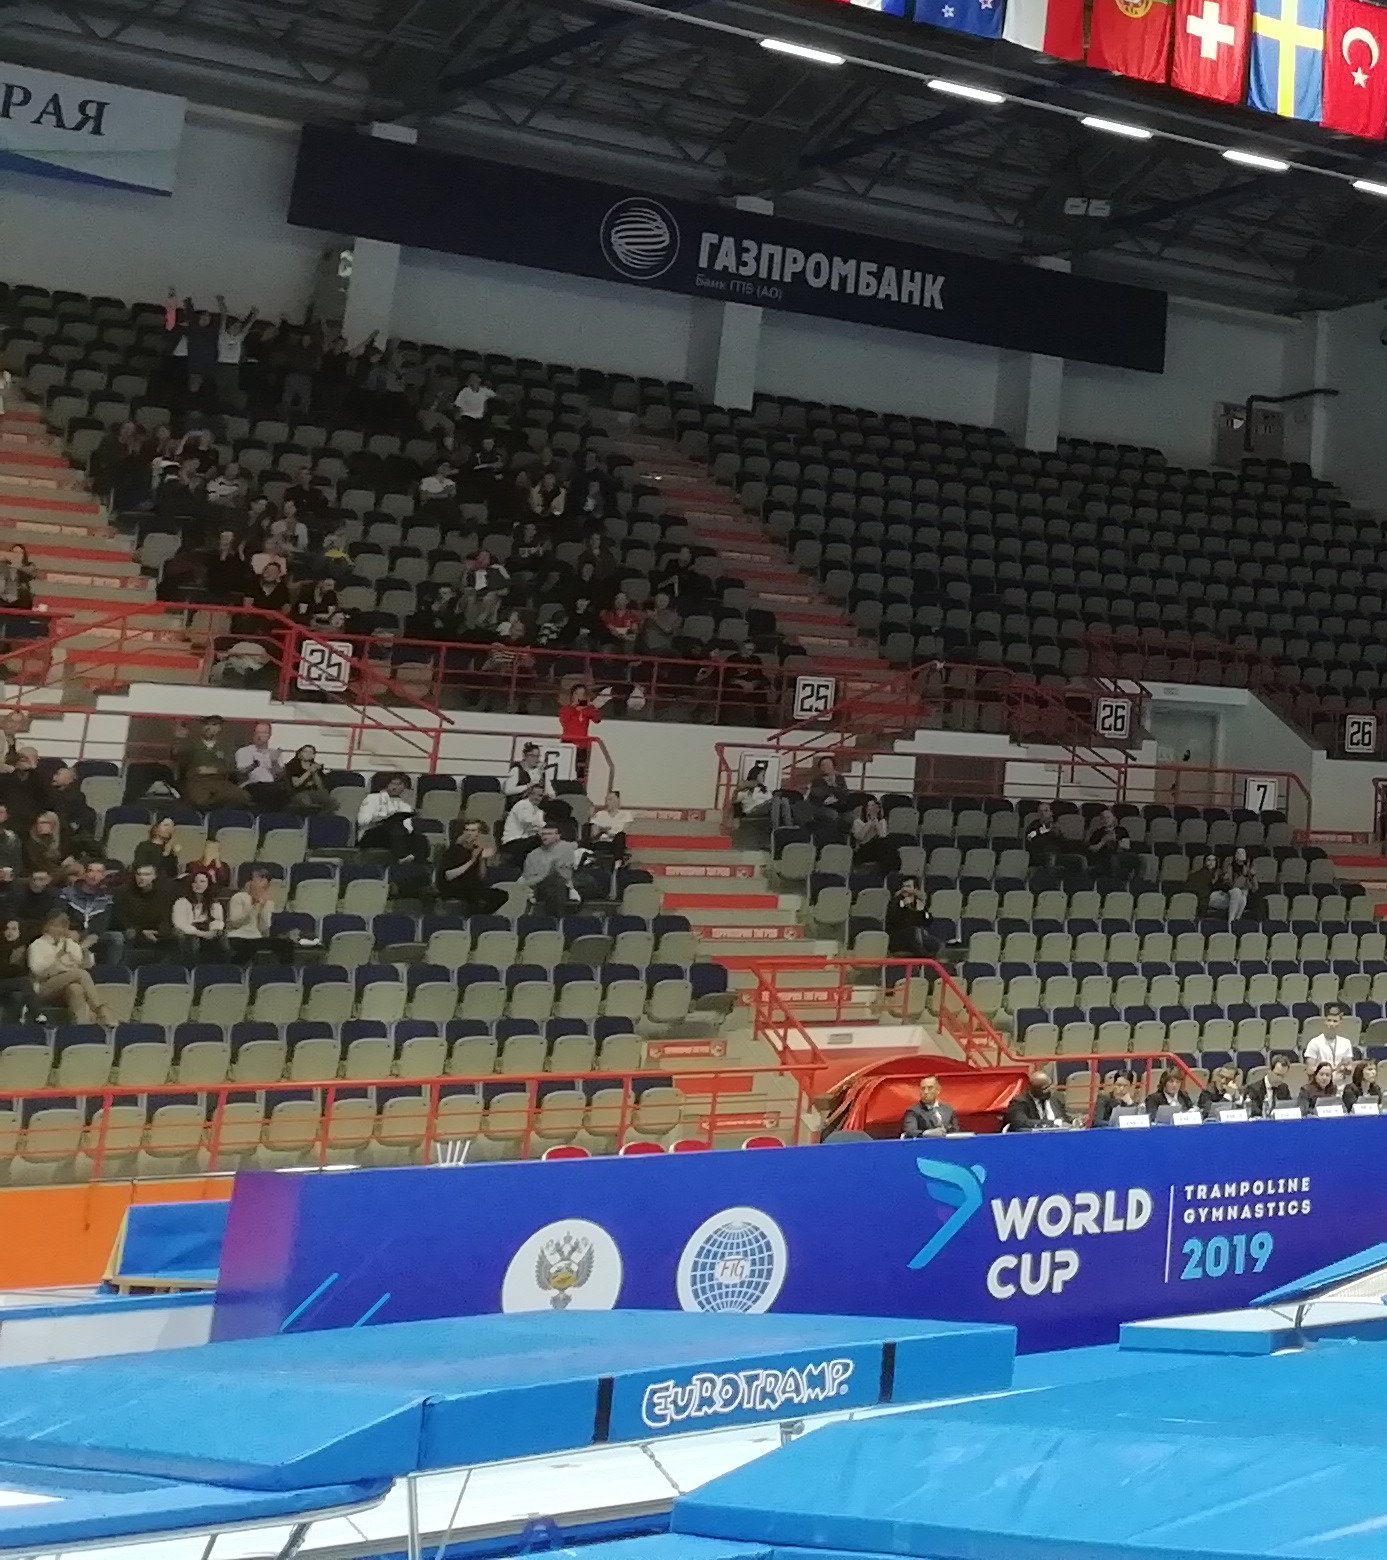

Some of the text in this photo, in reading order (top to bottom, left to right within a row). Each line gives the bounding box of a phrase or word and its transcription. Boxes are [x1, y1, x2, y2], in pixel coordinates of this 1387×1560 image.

[0, 82, 111, 137] РАЯ
[697, 231, 946, 311] ГАЗПРОМБАНК
[801, 682, 831, 713] 25
[1101, 702, 1126, 732] 26
[1350, 720, 1373, 747] 26
[1256, 784, 1268, 811] 7
[1184, 1176, 1312, 1201] TRAMPOLINE
[991, 1185, 1152, 1241] WORLD
[1182, 1197, 1313, 1225] GYMNASTICS
[986, 1247, 1081, 1299] CUP
[1180, 1231, 1275, 1281] 2019
[641, 1358, 855, 1429] EUROTRAMP
